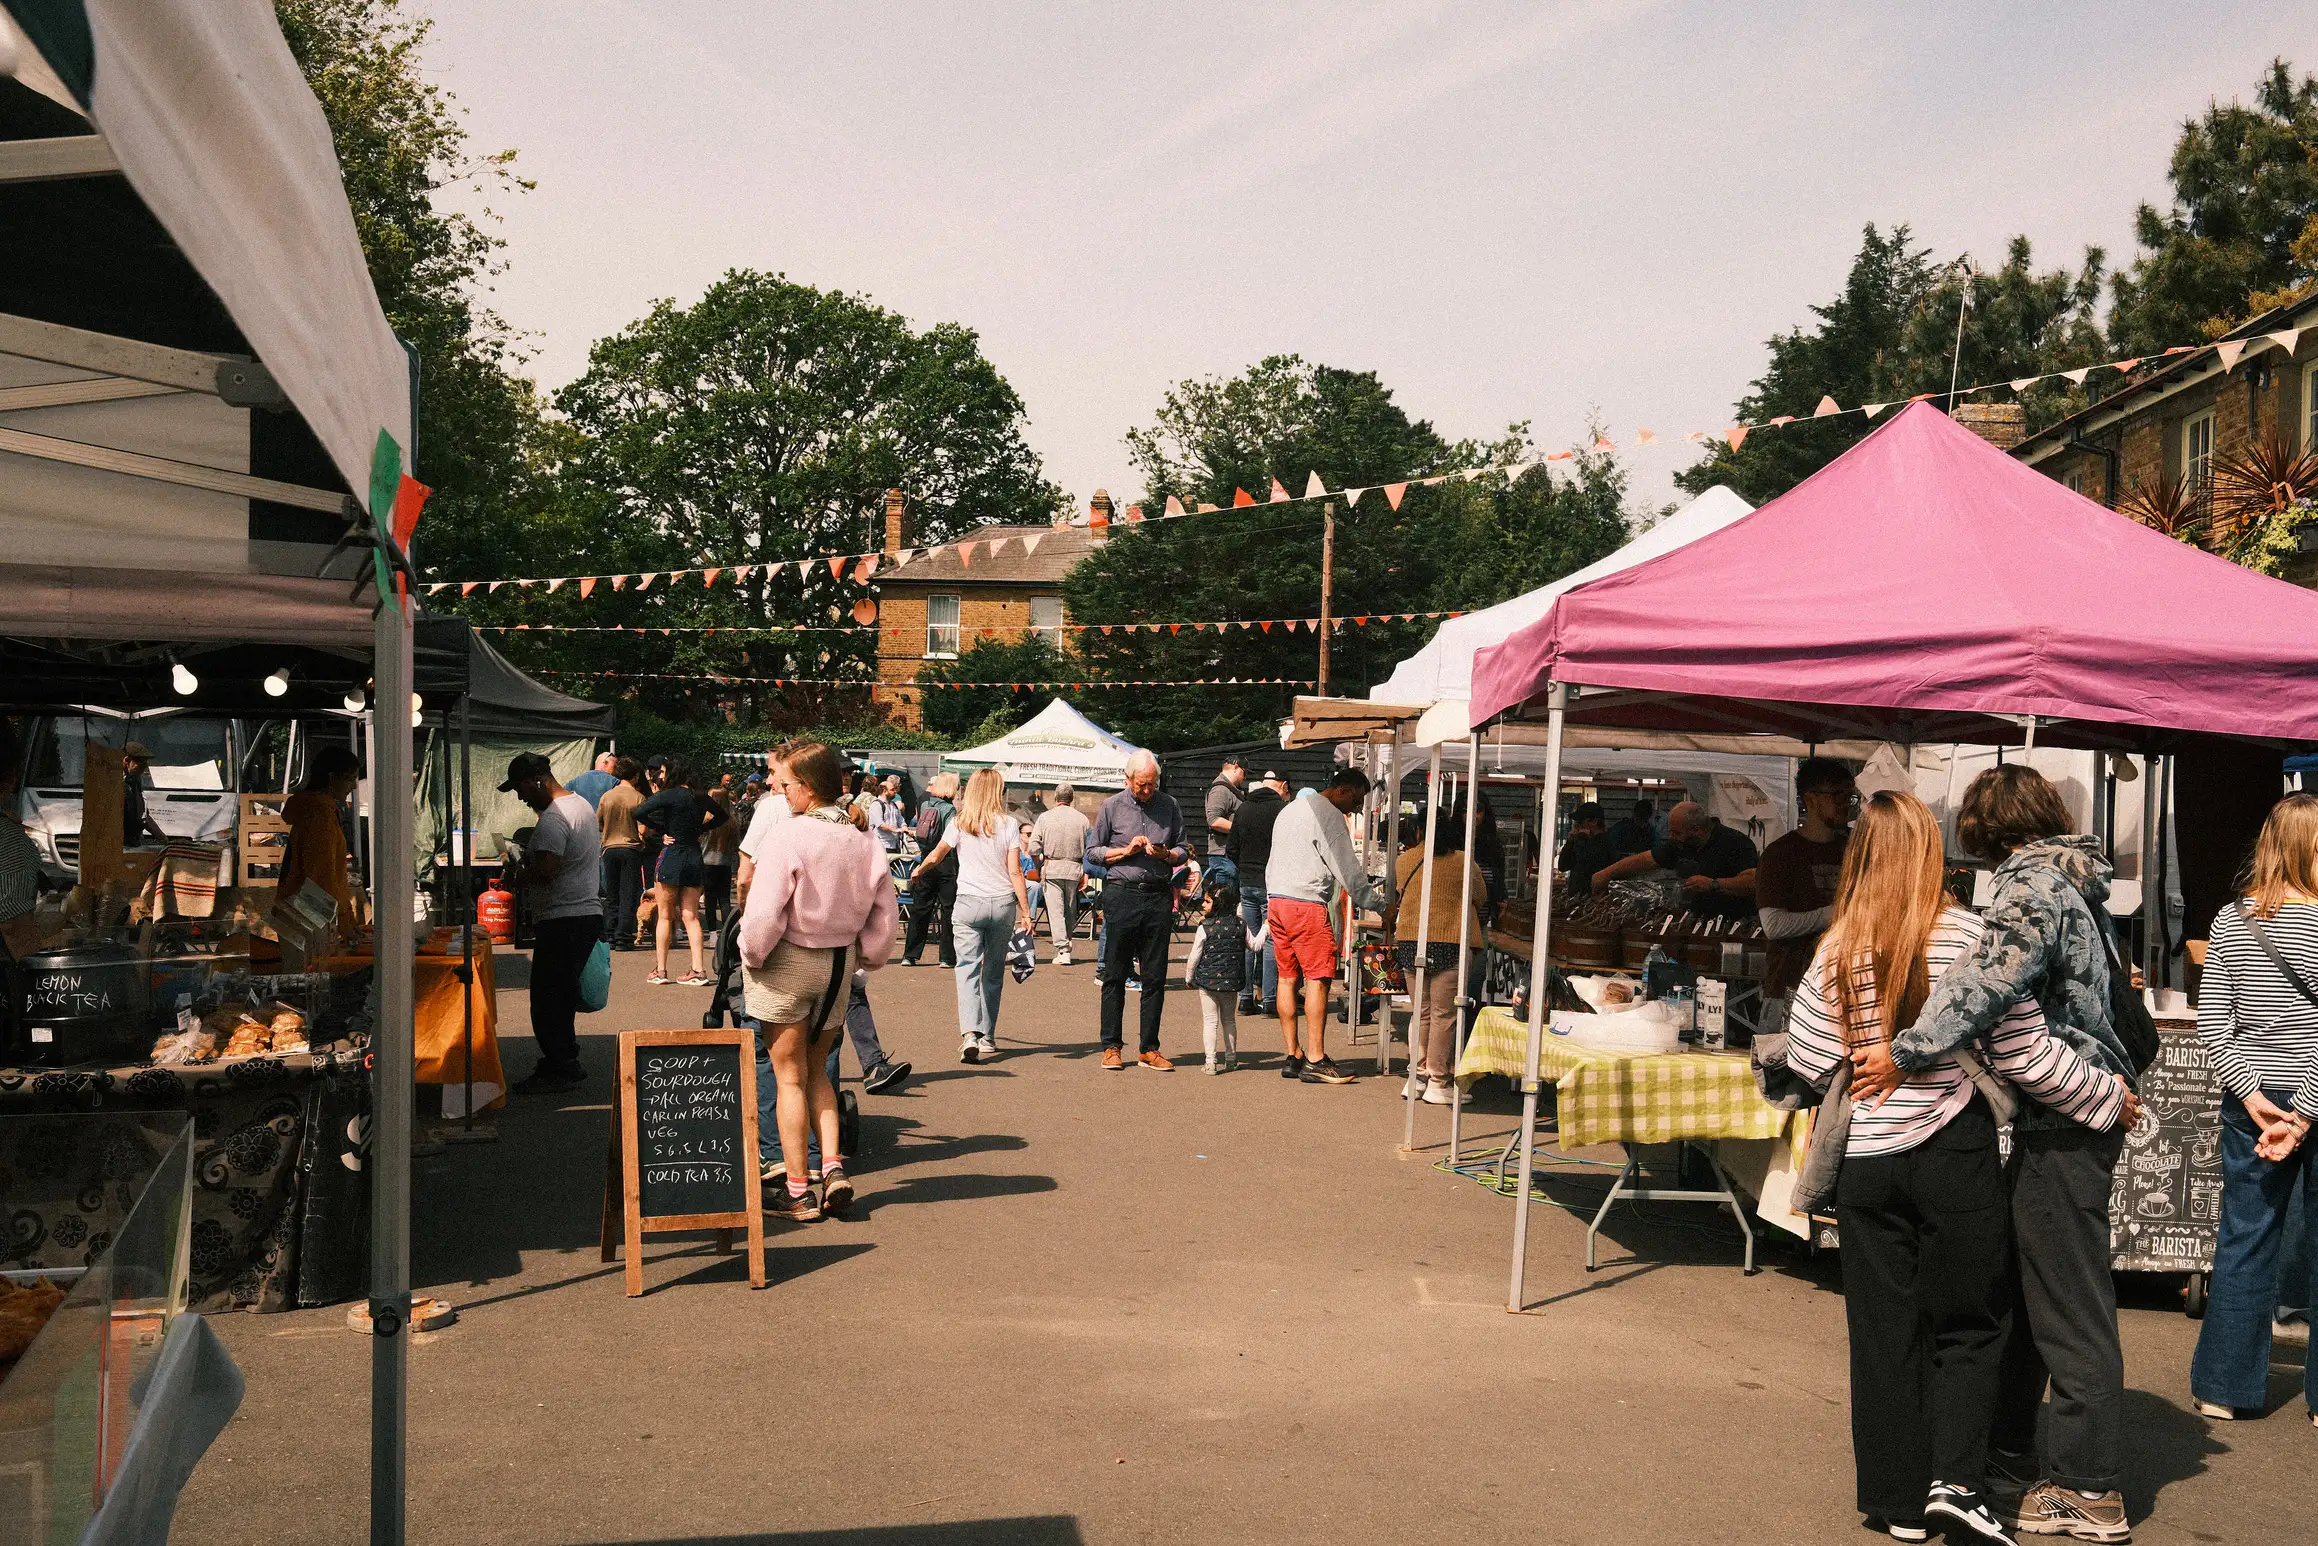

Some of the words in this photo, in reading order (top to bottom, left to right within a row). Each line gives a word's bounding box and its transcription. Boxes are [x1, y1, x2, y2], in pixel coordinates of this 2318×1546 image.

[1020, 762, 1038, 771] FRESH
[1039, 763, 1073, 774] TRADITIONAL
[1074, 766, 1093, 775] CURRY
[35, 975, 82, 992] LEMON
[26, 992, 68, 1012] BLACK
[70, 991, 112, 1011] TEA
[647, 1055, 699, 1072] SOUP
[2165, 1047, 2215, 1069] BARISTA
[641, 1072, 732, 1090] SOURDOUGH
[2187, 1070, 2208, 1081] FRESH
[2168, 1081, 2207, 1092] Passionate
[647, 1125, 678, 1139] VEG
[2134, 1156, 2180, 1171] CHOCOLATE
[685, 1168, 709, 1183] TEA
[2133, 1175, 2154, 1191] Please!
[2190, 1177, 2205, 1188] Take
[2151, 1236, 2202, 1257] BARISTA
[2174, 1258, 2196, 1270] FRESH
